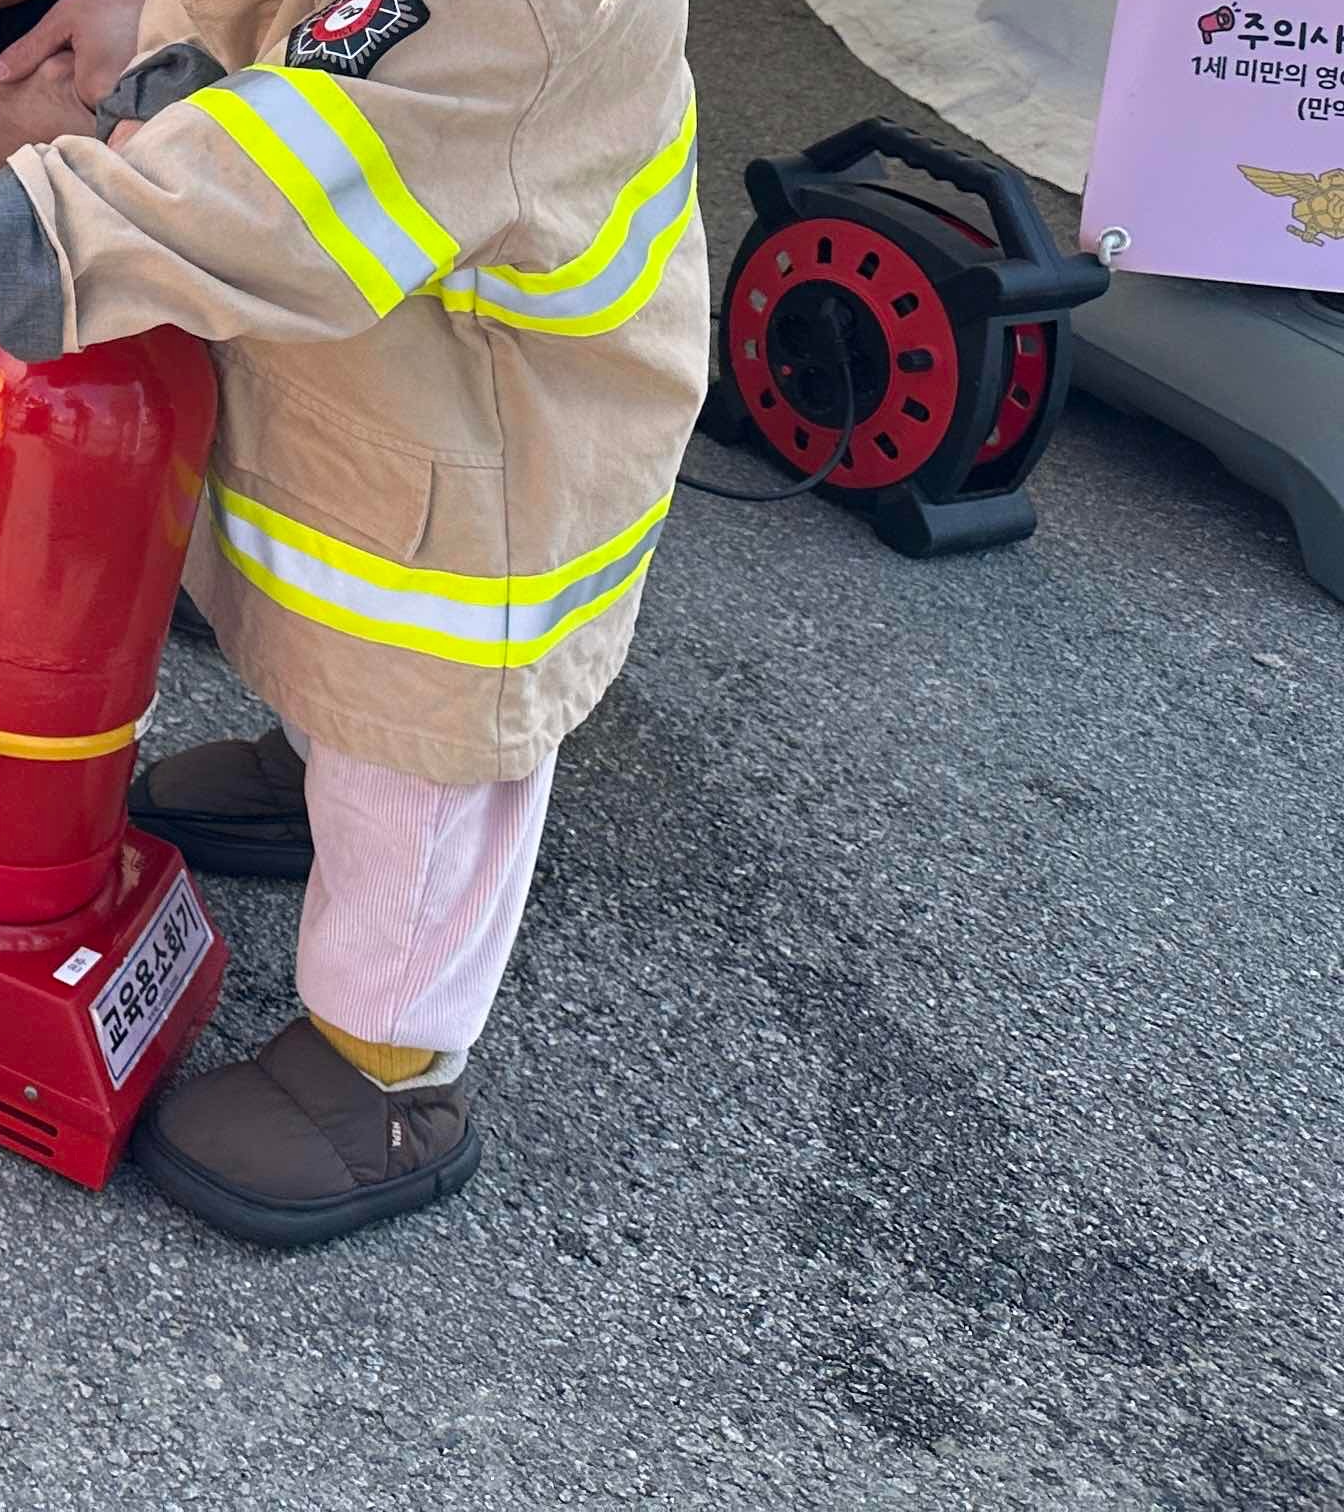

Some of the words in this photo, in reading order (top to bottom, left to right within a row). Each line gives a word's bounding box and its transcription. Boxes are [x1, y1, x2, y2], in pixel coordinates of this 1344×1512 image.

[1237, 12, 1344, 54] 주의사
[1191, 56, 1228, 80] 1세
[1235, 59, 1308, 88] 미만의
[1315, 66, 1344, 90] 영
[101, 891, 199, 1055] 교육용소화기
